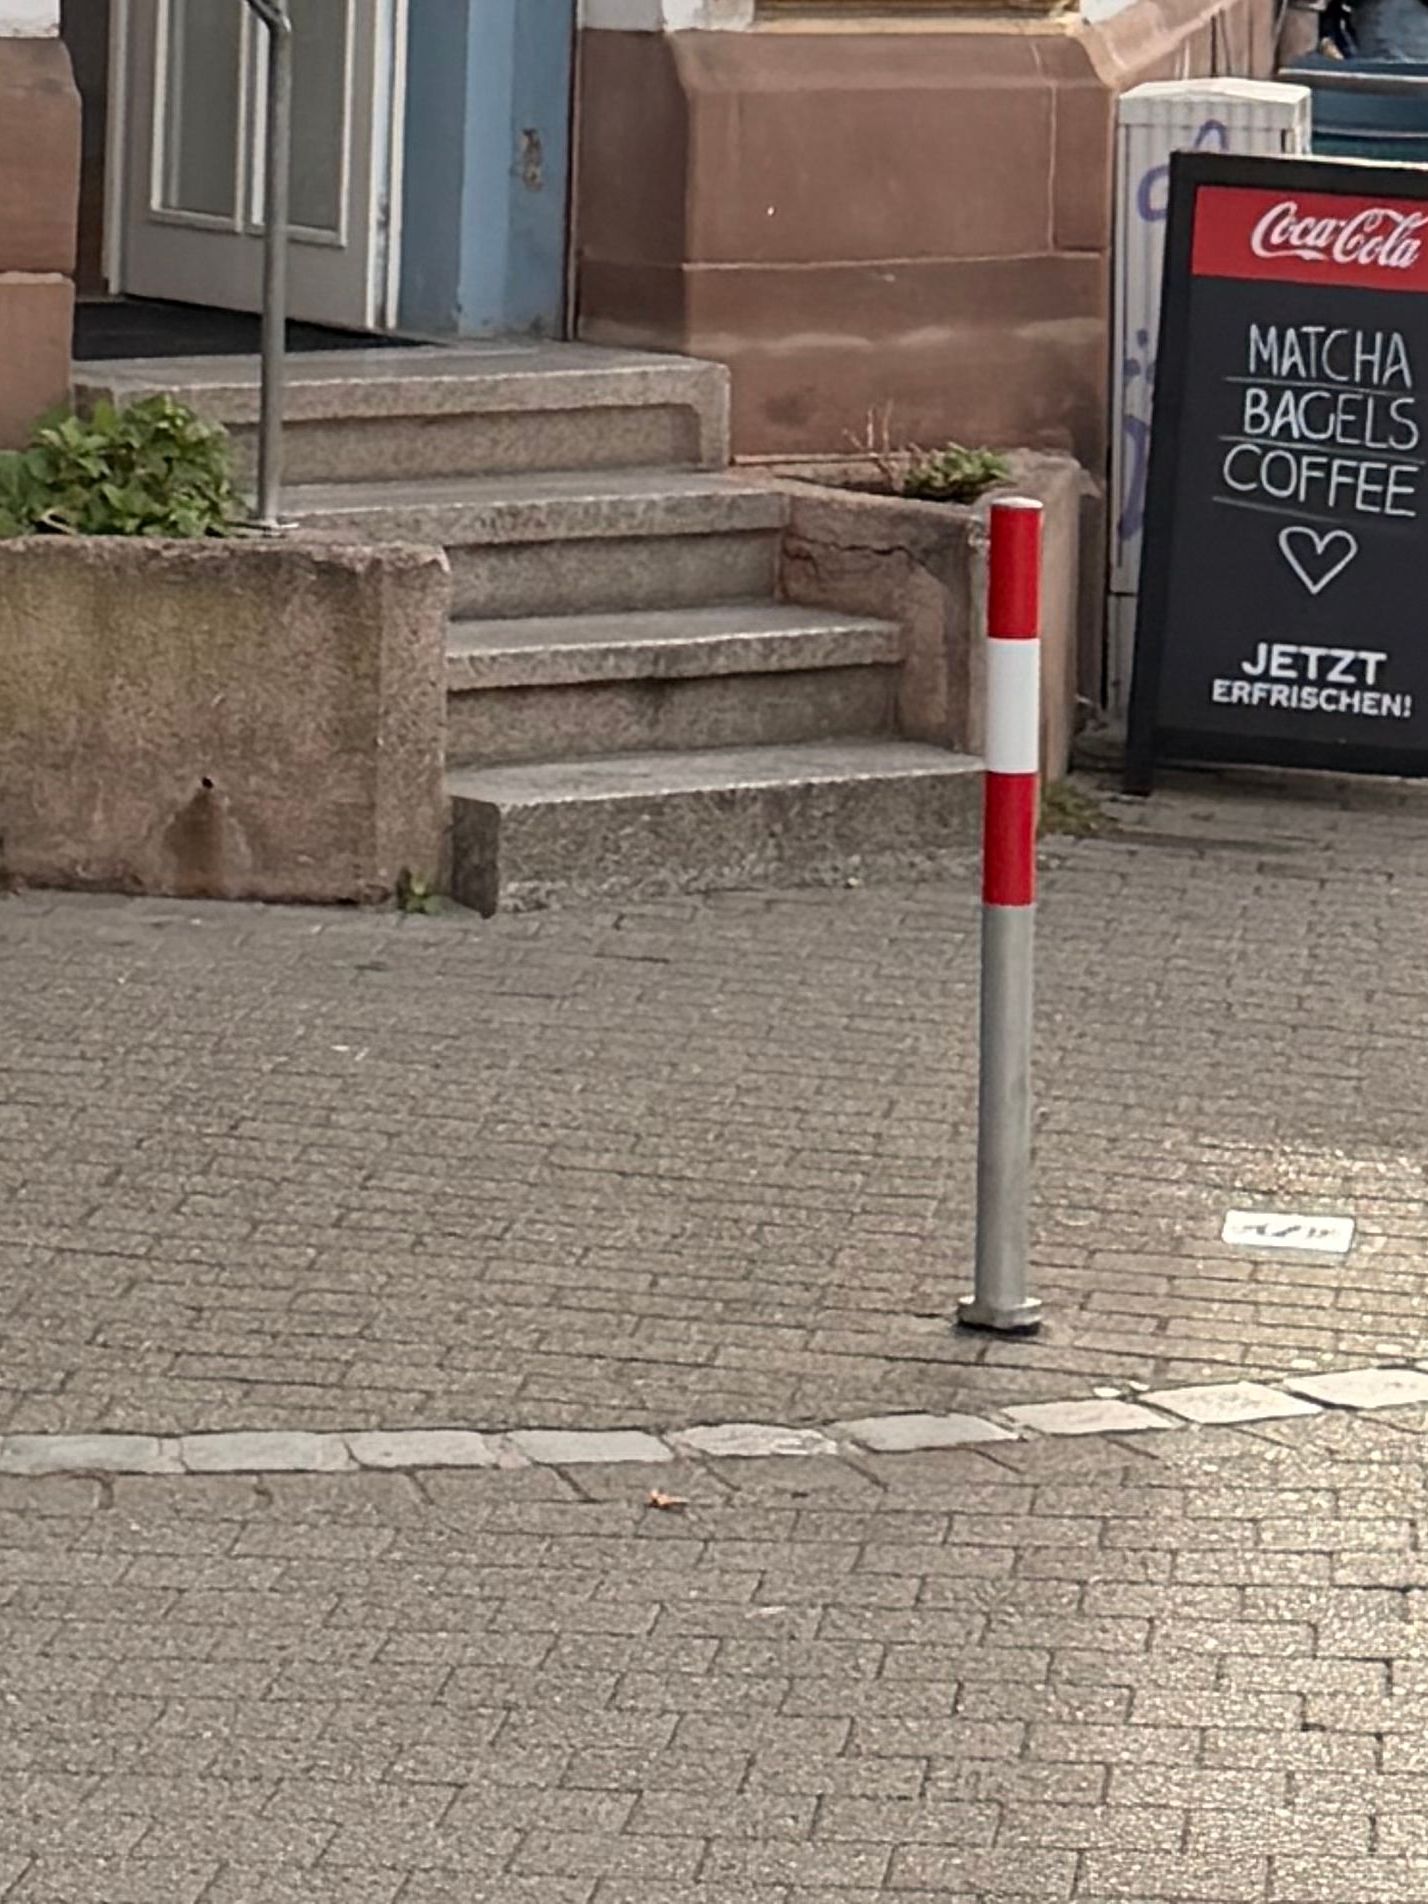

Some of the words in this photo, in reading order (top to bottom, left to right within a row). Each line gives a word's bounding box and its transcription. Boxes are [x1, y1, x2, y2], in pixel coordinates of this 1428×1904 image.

[1248, 323, 1412, 388] MATCHA
[1243, 388, 1419, 451] BAGELS
[1222, 443, 1418, 518] COFFEE
[1242, 642, 1388, 686] JETZT
[1211, 678, 1413, 719] ERFRISCHEN!
